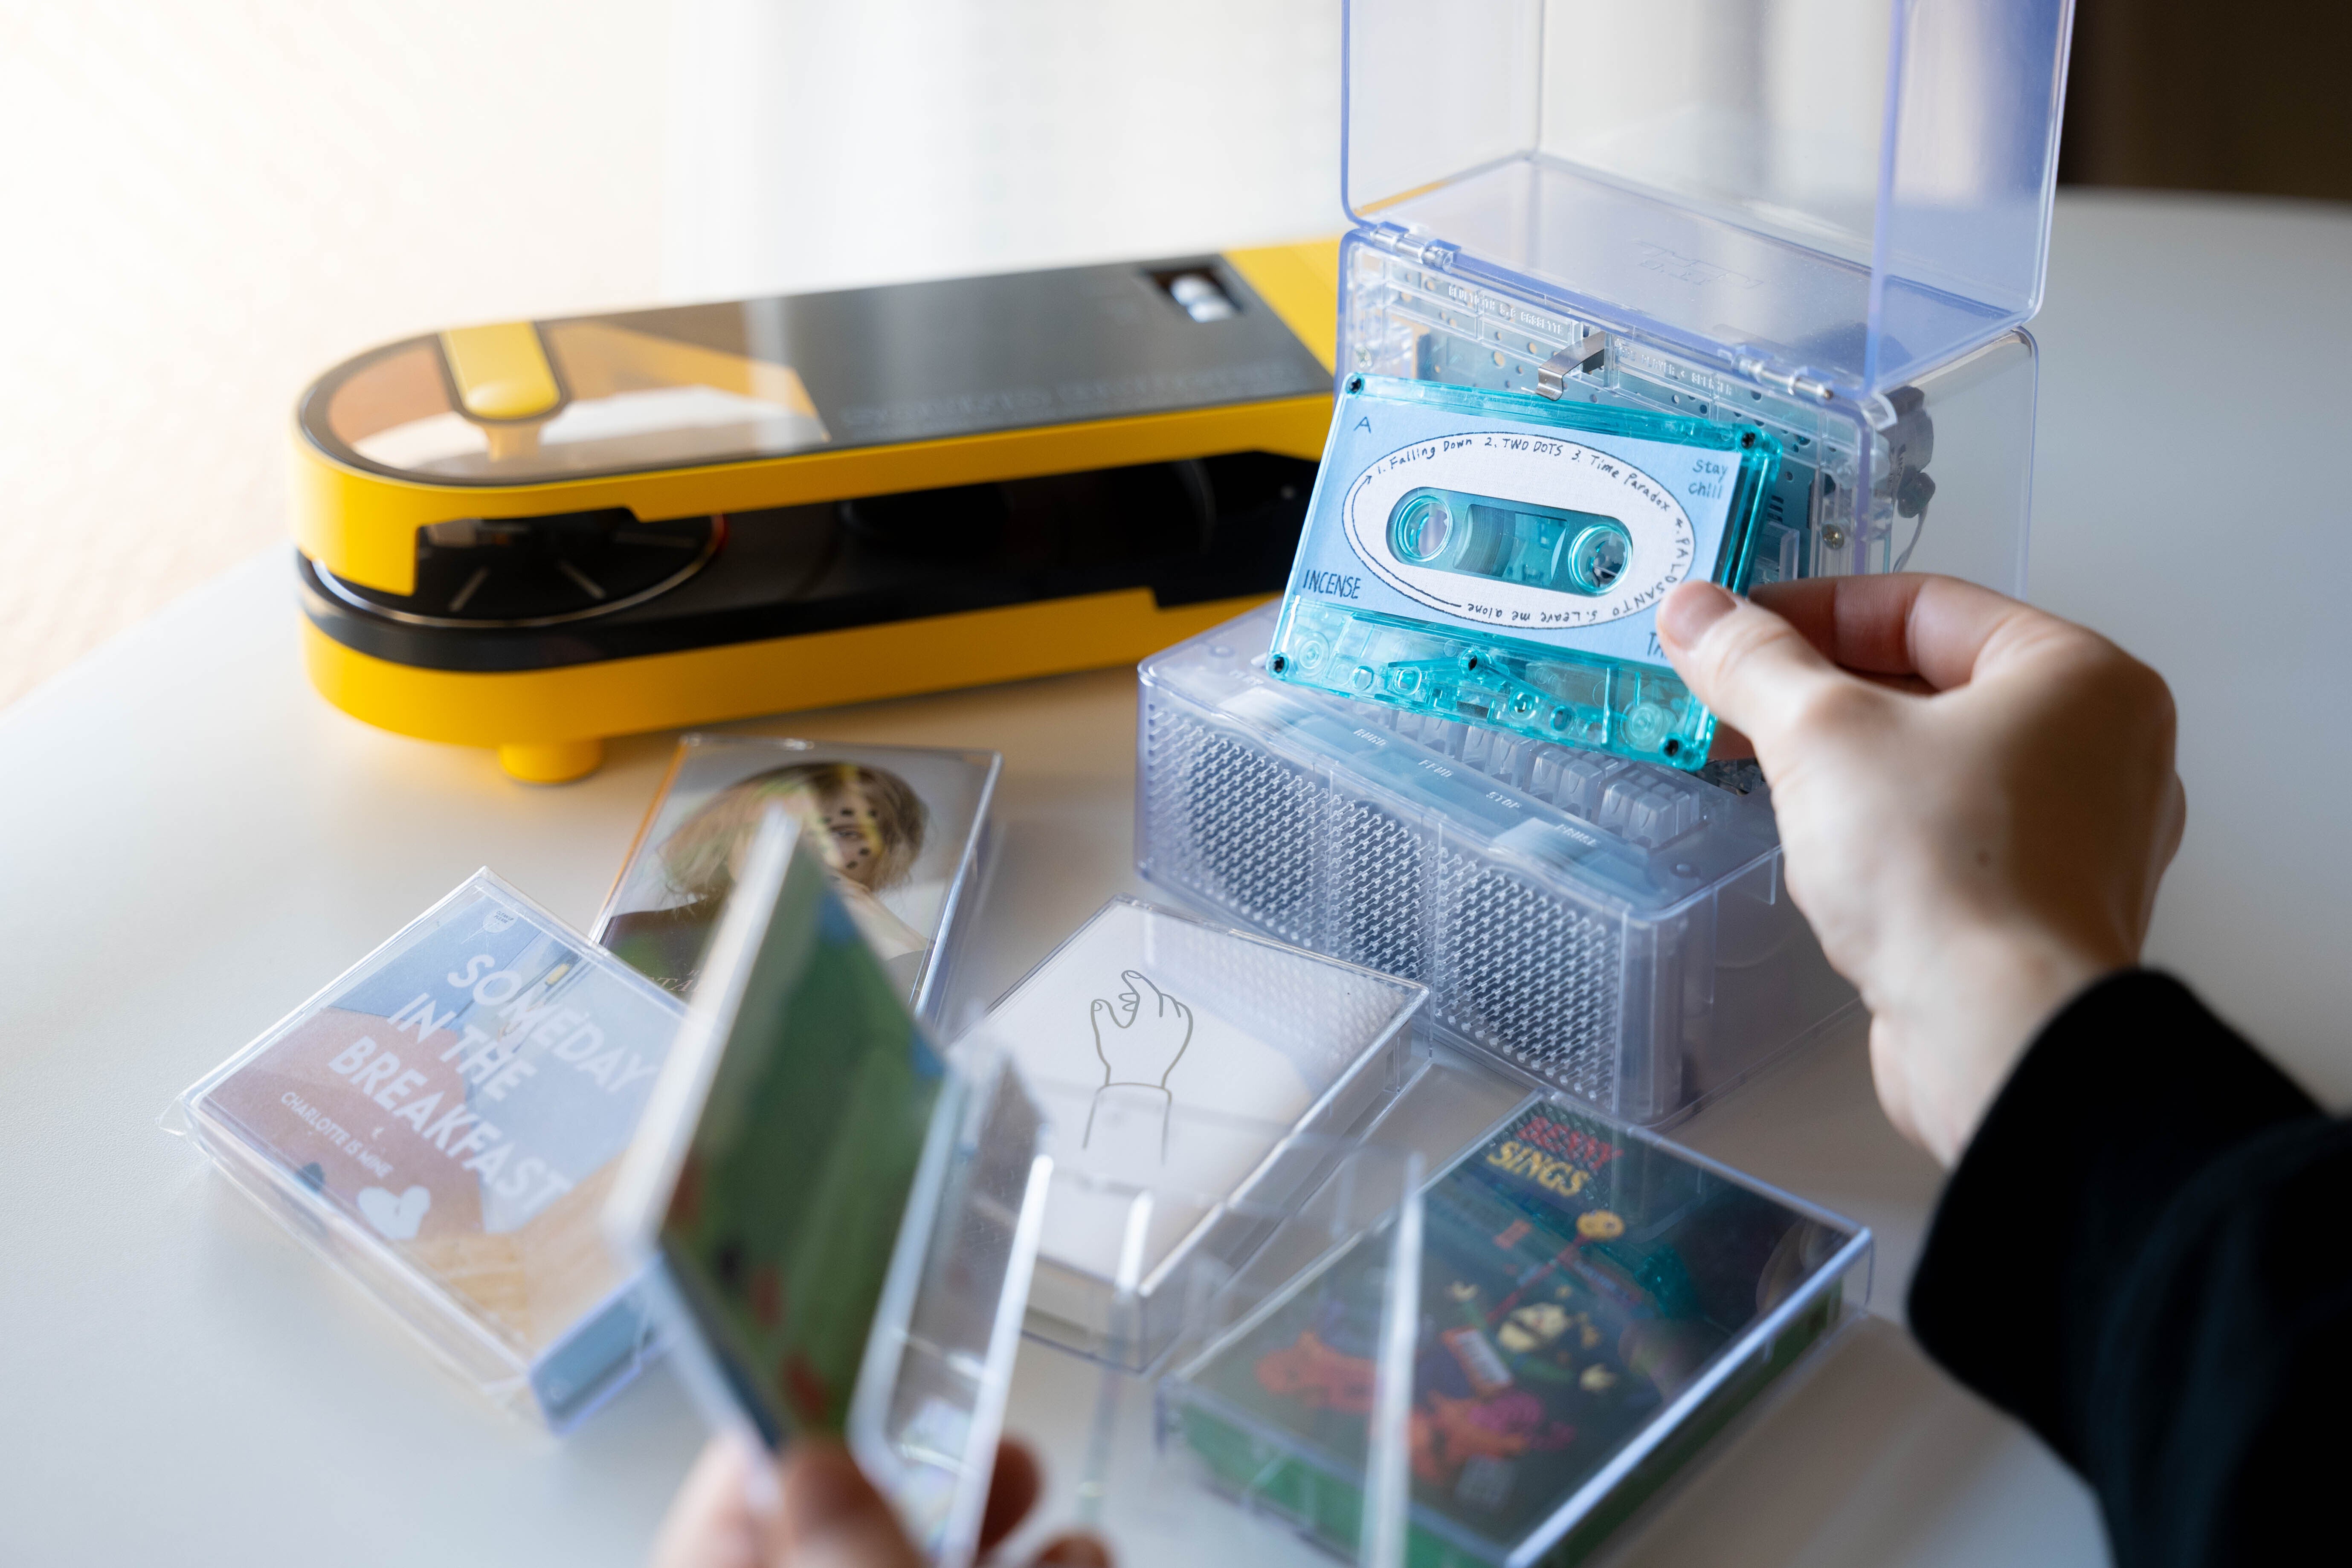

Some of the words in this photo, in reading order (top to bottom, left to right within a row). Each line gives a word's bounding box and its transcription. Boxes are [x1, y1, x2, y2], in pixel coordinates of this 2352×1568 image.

[1354, 416, 1372, 434] A
[1377, 466, 1386, 475] 1.
[1390, 447, 1436, 470] Falling
[1444, 438, 1473, 452] Down
[1484, 437, 1497, 449] 2.
[1502, 438, 1528, 451] TWO
[1533, 441, 1563, 456] DOTS
[1572, 450, 1581, 463] 3.
[1590, 455, 1620, 478] Time
[1624, 473, 1670, 512] Paradox
[1302, 569, 1361, 599] INCENSE
[1467, 603, 1503, 618] alone
[1511, 610, 1531, 621] me
[1485, 791, 1523, 808] STOP
[447, 954, 659, 1094] SOMEDAY
[387, 993, 455, 1044] IN
[440, 1025, 538, 1101] THE
[280, 1091, 351, 1146] CHARLOTTE
[357, 1151, 394, 1179] MINE
[328, 1035, 575, 1210] BREAKFAST
[1487, 1140, 1590, 1198] SINGS
